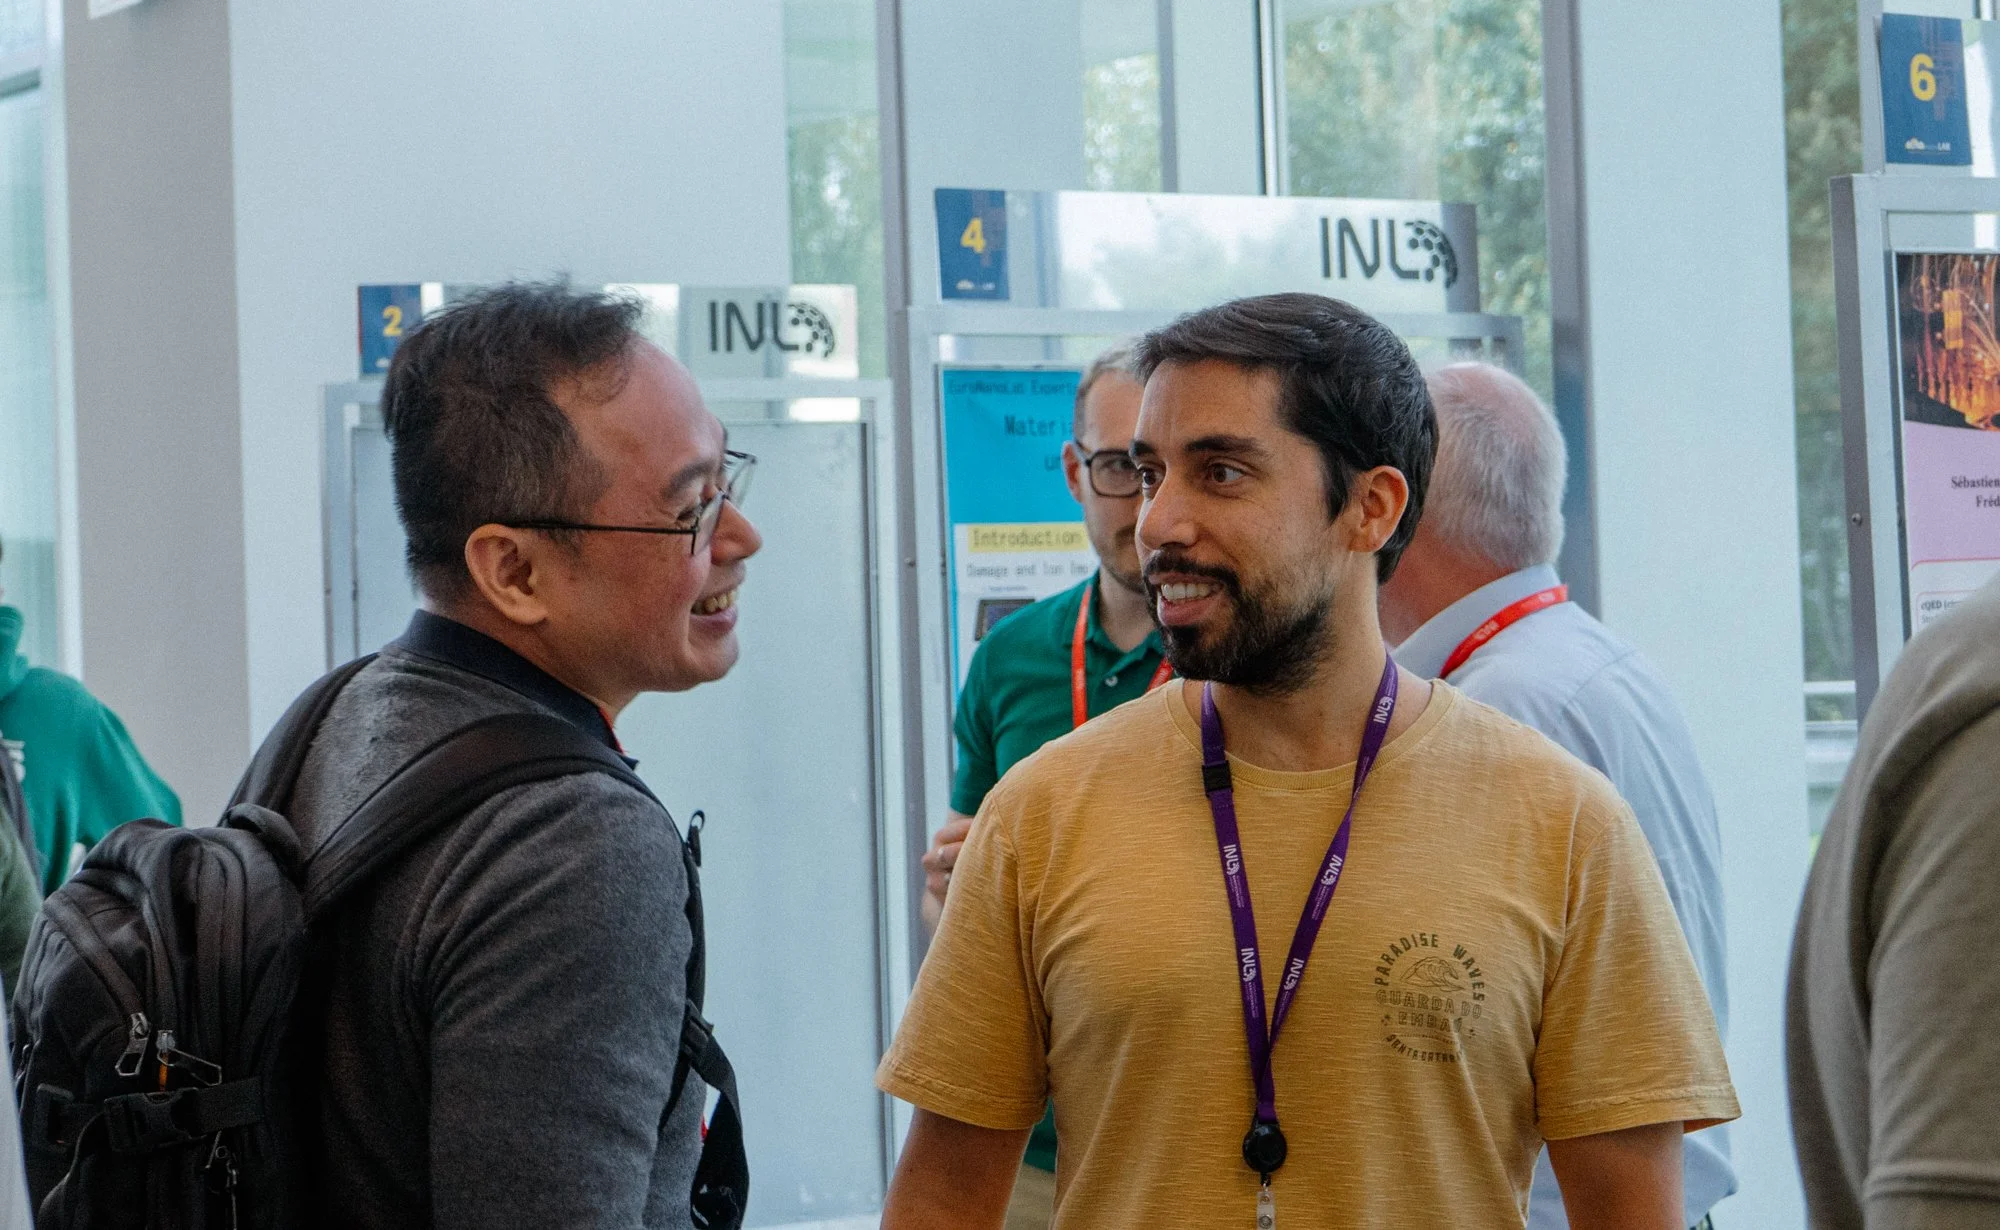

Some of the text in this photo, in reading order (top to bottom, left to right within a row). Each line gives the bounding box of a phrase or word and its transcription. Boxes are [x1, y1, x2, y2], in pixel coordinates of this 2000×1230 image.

[1910, 53, 1937, 102] 6
[960, 217, 986, 254] 4
[1321, 217, 1420, 280] INL
[382, 306, 403, 337] 2
[710, 301, 800, 352] INL
[972, 528, 1082, 548] Introduction
[1016, 562, 1037, 576] and
[1223, 844, 1238, 872] INL
[1323, 854, 1342, 880] INL
[1241, 948, 1255, 977] INL
[1286, 958, 1304, 986] INL
[1374, 932, 1485, 1001] PARADISE WAVES
[1375, 989, 1455, 1014] GUARDA
